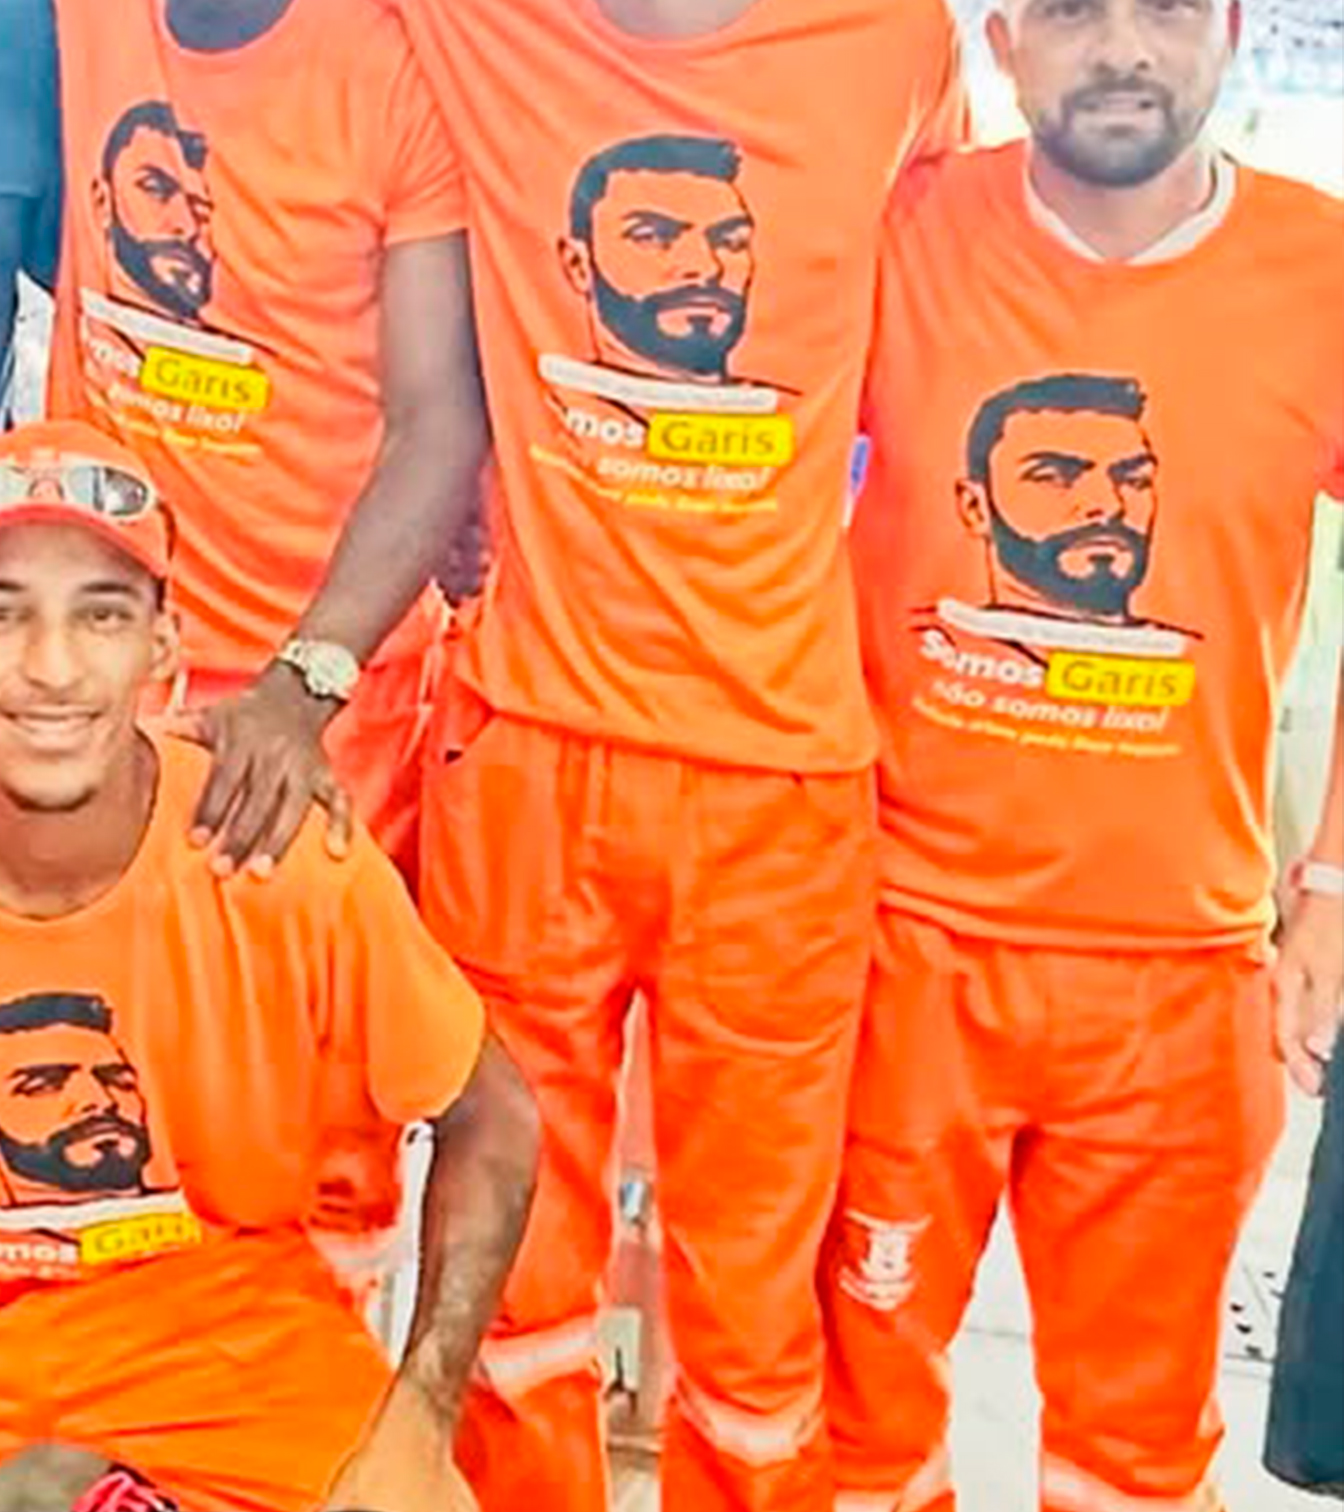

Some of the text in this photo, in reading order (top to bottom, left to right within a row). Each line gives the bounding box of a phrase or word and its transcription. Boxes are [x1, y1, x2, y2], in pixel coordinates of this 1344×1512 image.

[155, 356, 253, 405] Garis
[661, 419, 777, 456] Garis
[918, 628, 1178, 698] Somos Garis
